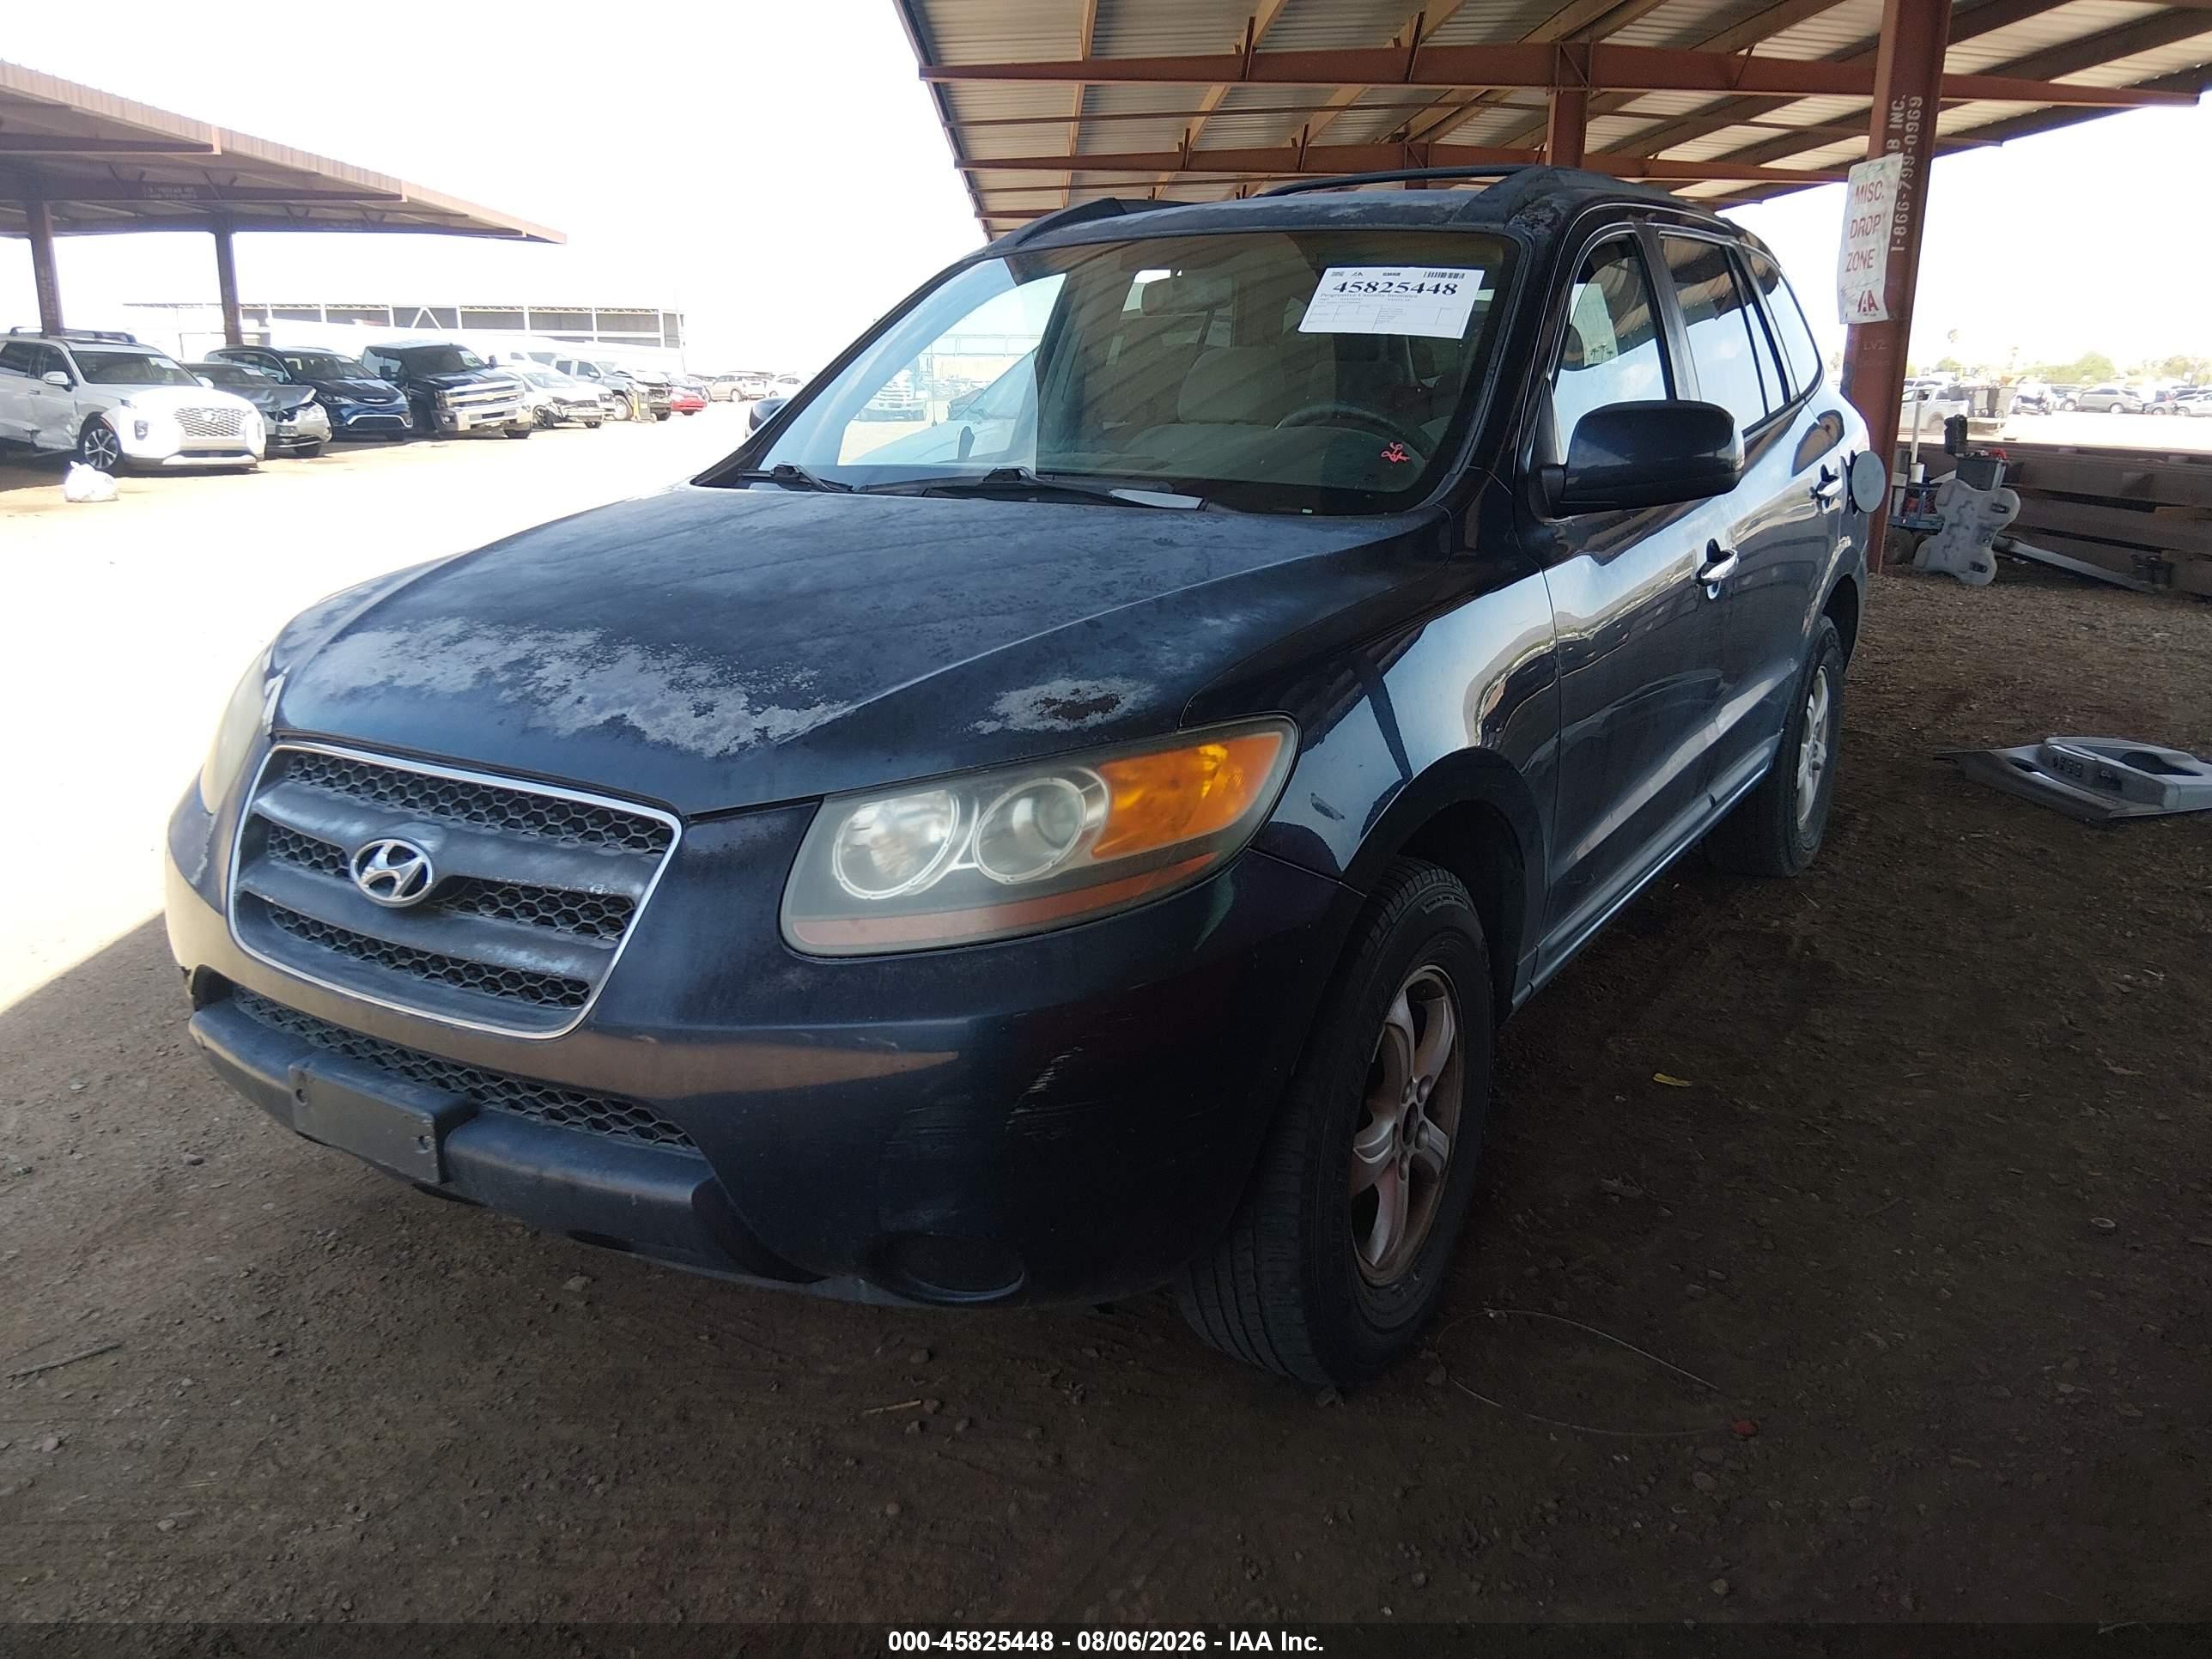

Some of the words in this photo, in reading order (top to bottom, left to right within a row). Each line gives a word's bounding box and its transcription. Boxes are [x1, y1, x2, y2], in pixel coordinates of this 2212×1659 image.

[1888, 94, 1906, 130] INC.
[1890, 95, 1923, 252] 1-866-799-0969
[1855, 179, 1885, 206] MISC.
[1850, 215, 1881, 240] DROP
[1845, 248, 1875, 272] ZONE
[1333, 281, 1459, 296] 45825448
